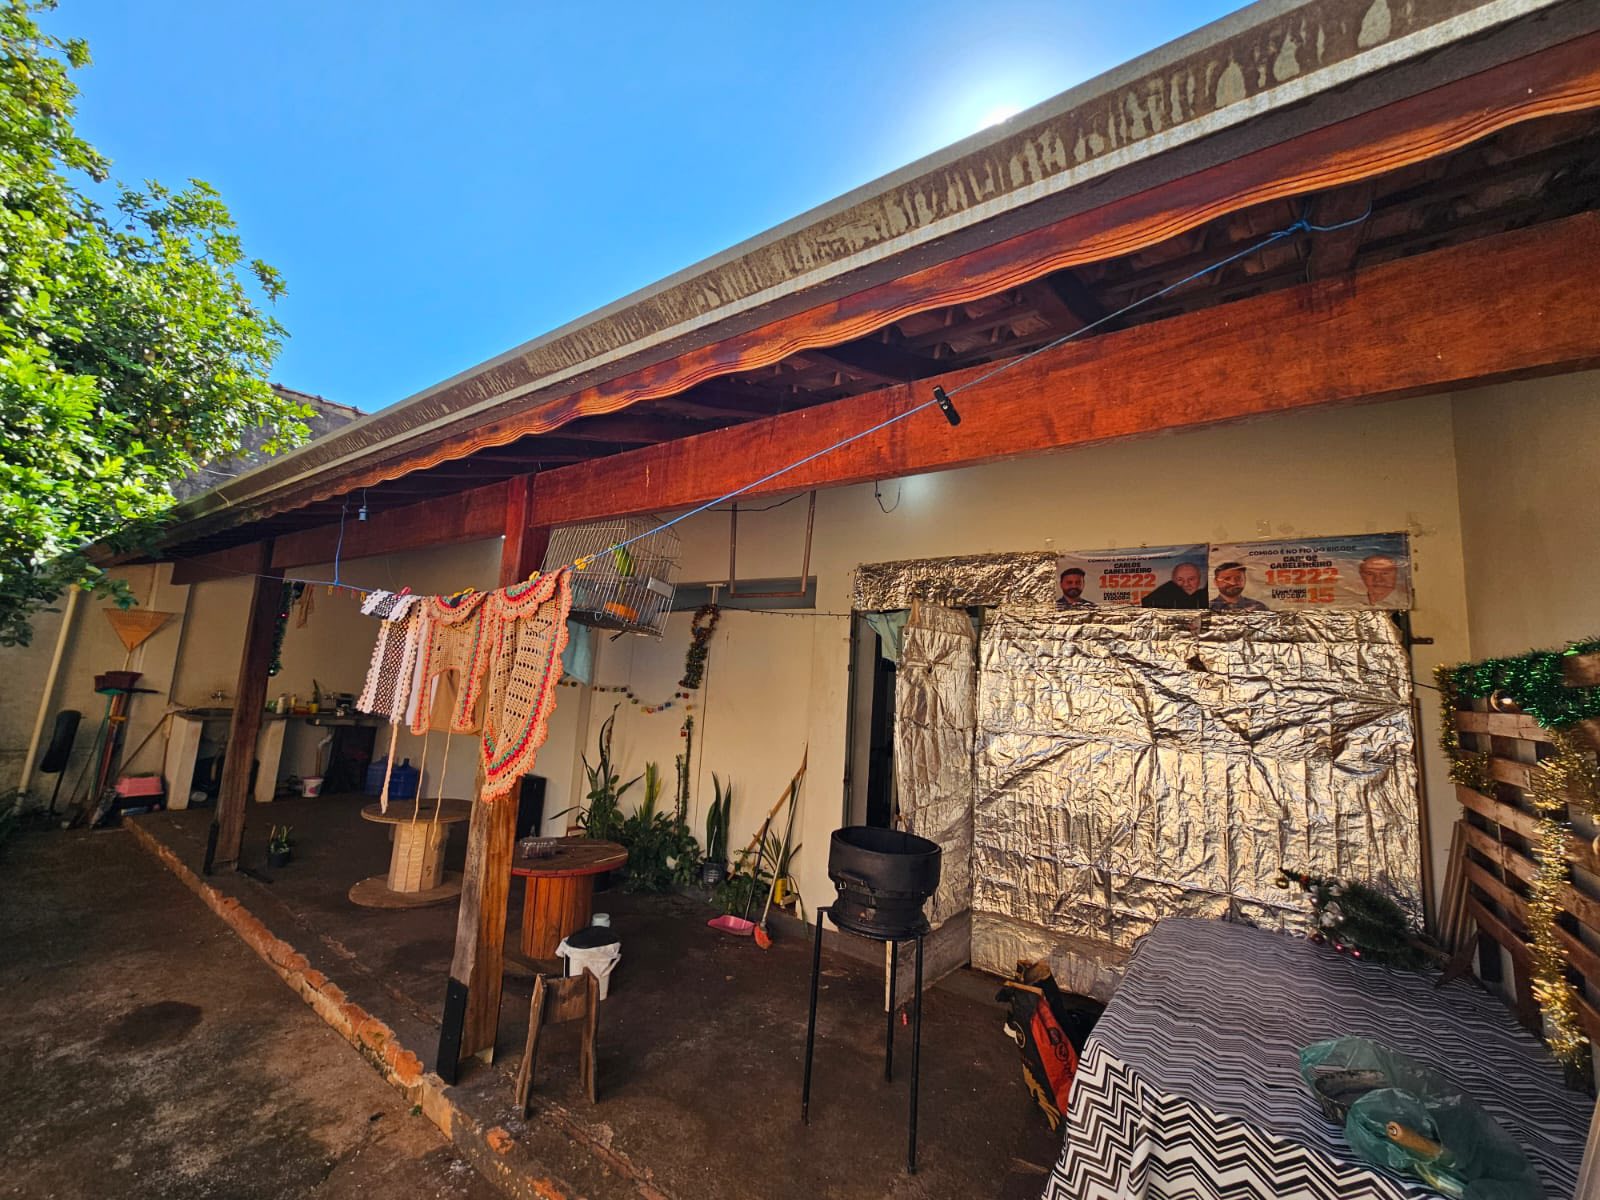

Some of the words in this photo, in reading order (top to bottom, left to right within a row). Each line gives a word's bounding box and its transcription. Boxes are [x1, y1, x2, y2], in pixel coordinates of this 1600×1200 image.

[1270, 561, 1332, 569] CABELEIREIRO
[1099, 574, 1156, 588] 15222
[1265, 567, 1339, 585] 15222
[1308, 587, 1335, 603] 15
